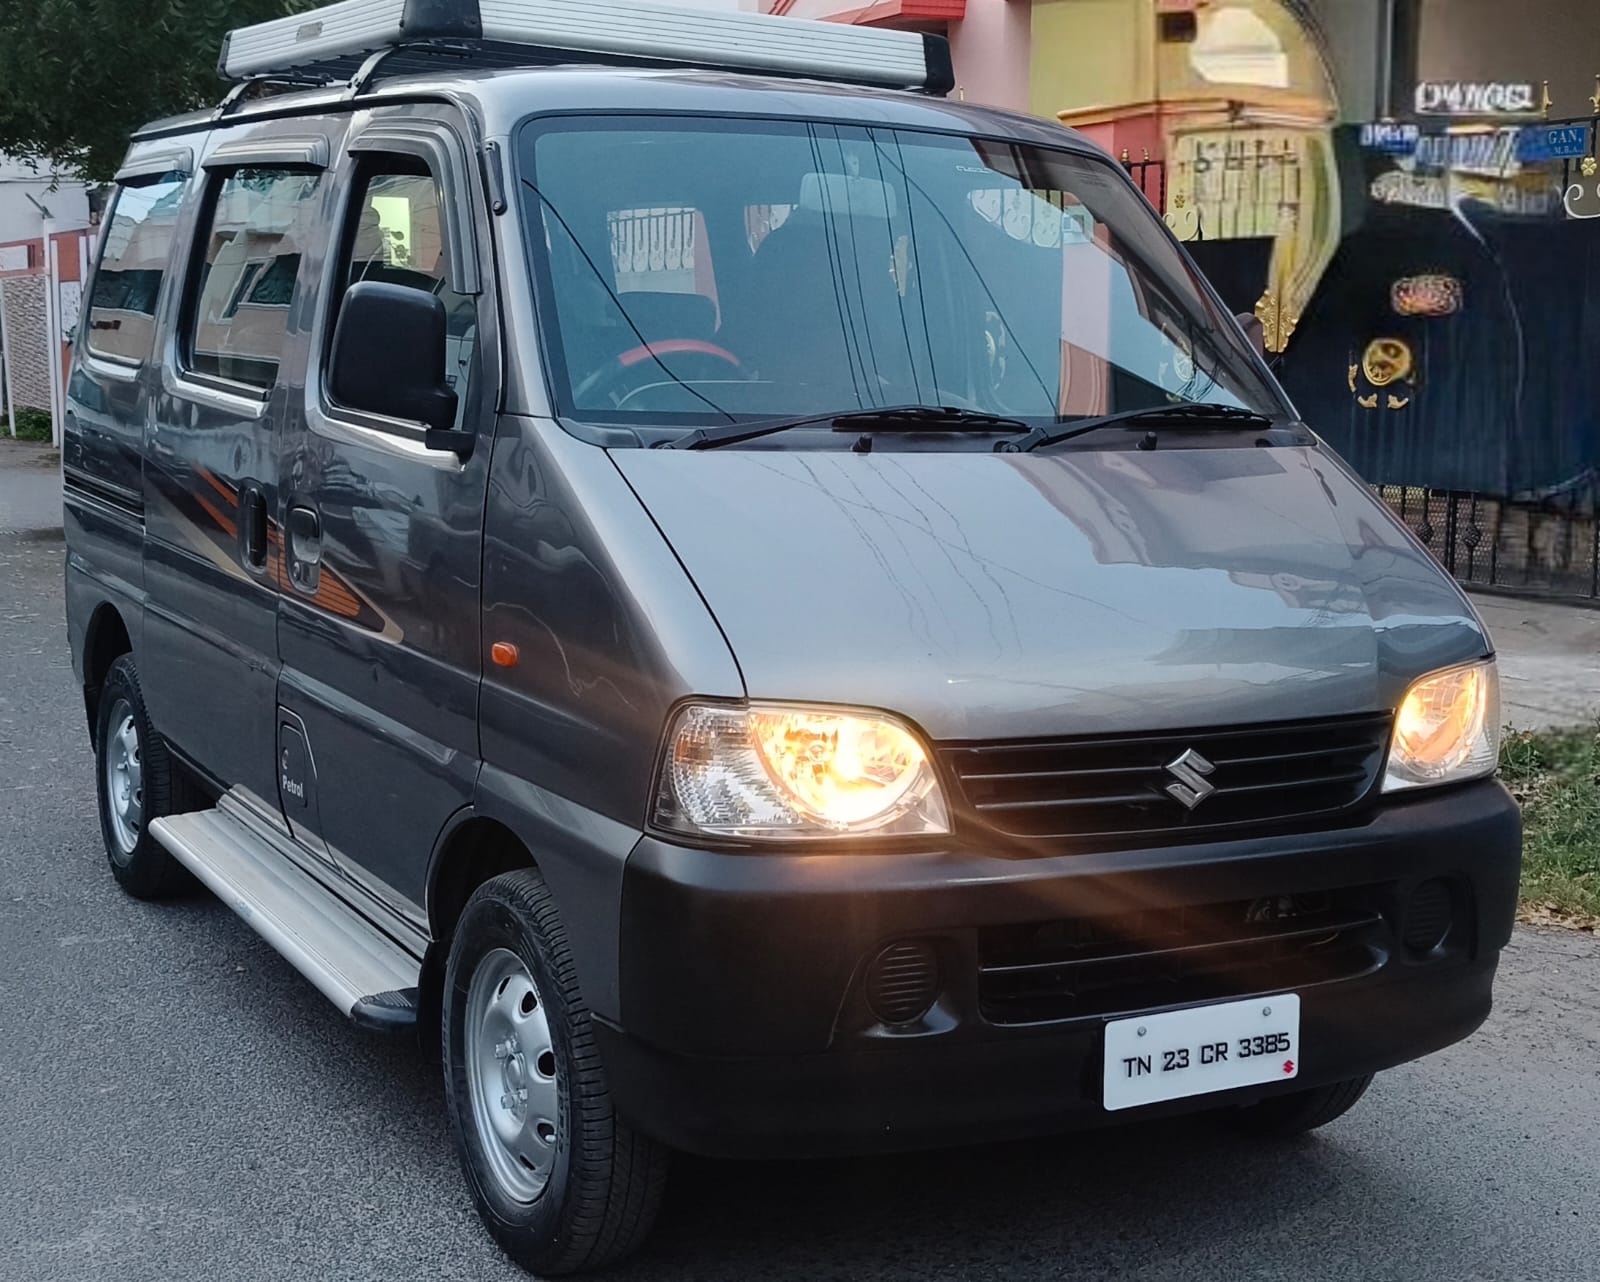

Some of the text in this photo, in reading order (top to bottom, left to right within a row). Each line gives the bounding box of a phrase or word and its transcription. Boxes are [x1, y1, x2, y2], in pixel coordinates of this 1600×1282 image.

[282, 774, 303, 798] Petrol
[1122, 1032, 1290, 1077] TN 23 CR 3385
